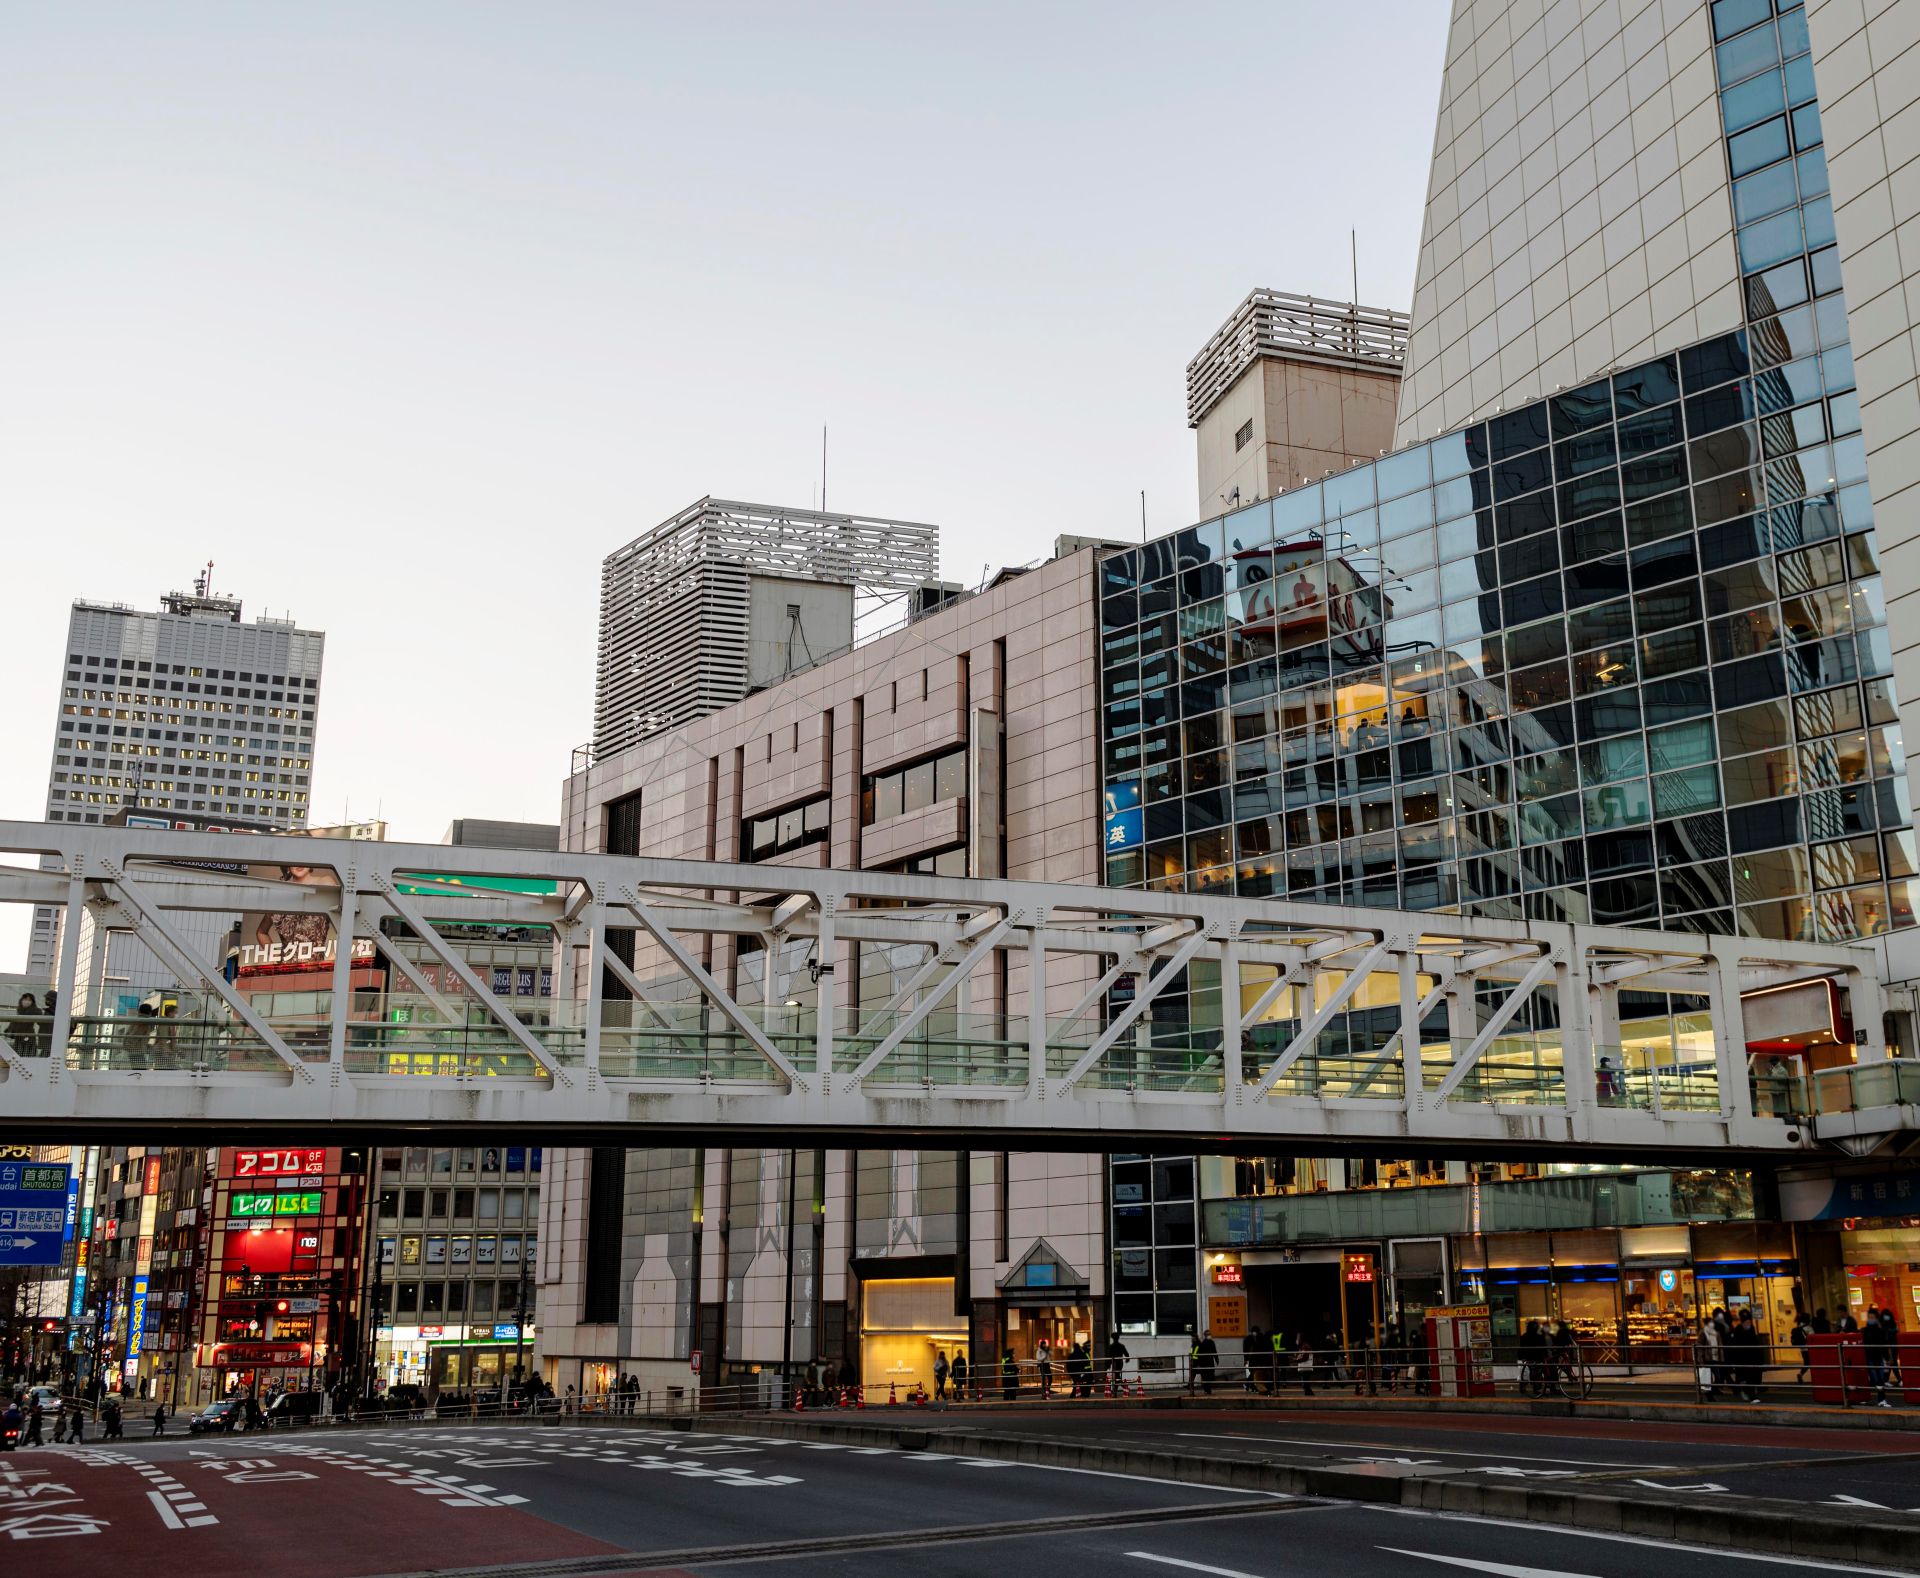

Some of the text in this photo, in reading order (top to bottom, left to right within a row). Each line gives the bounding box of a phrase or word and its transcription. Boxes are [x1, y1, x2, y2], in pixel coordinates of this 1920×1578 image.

[240, 1152, 299, 1173] アコム
[2, 1166, 16, 1181] 台
[25, 1169, 64, 1181] 首都高
[22, 1181, 63, 1189] SHUTOKO EXP
[18, 1211, 62, 1223] 新宿駅西口
[453, 1247, 537, 1257] タイセイ・ハウ
